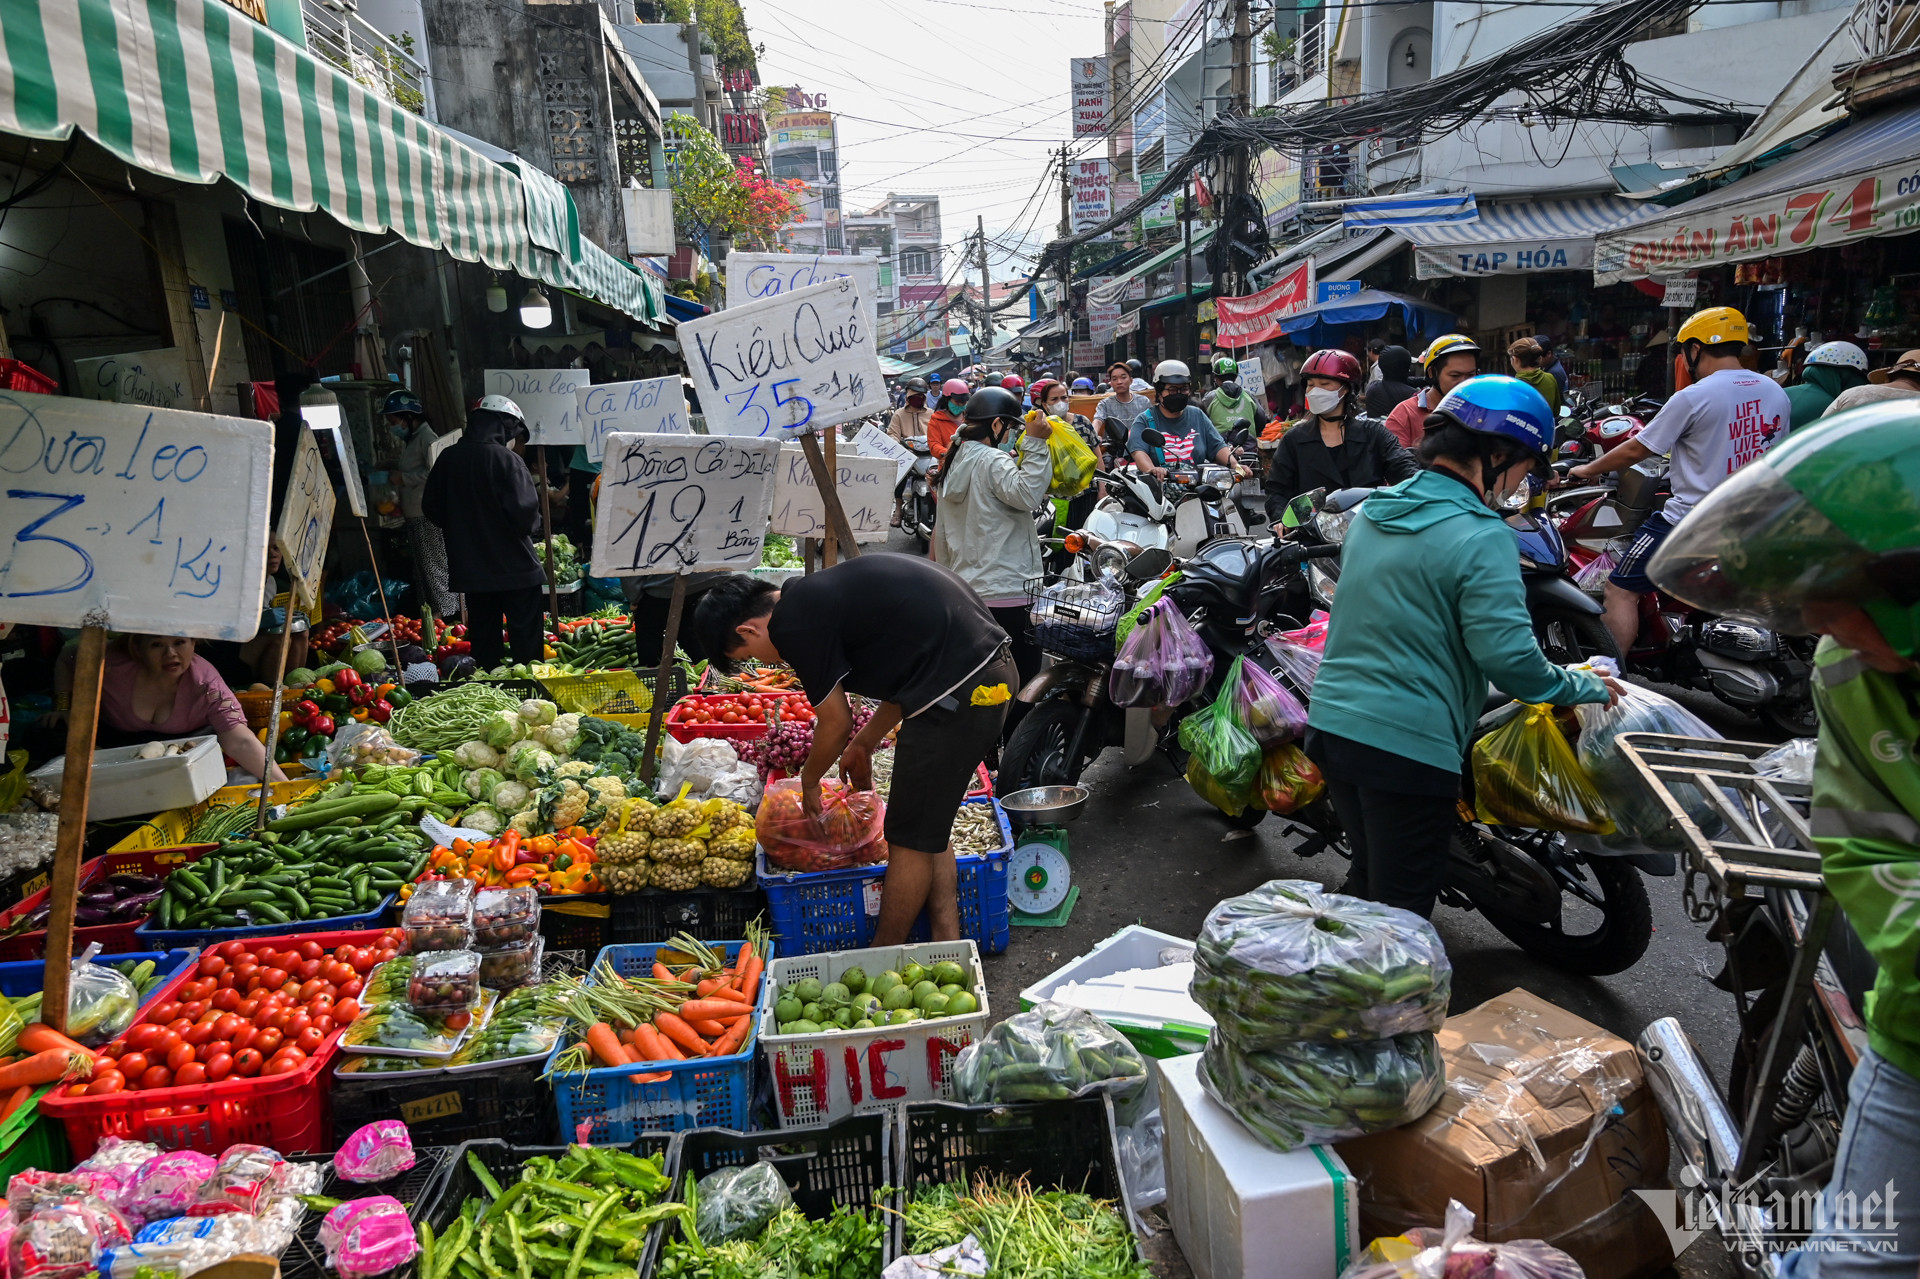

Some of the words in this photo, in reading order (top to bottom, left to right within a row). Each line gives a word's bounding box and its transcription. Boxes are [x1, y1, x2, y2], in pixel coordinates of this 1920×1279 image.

[1628, 226, 1717, 273] QUÁN
[1724, 213, 1780, 257] ĂN
[1784, 176, 1886, 246] 74
[1458, 251, 1508, 275] TẠP
[1516, 244, 1568, 269] HÓA
[724, 378, 816, 437] 35
[1736, 399, 1761, 419] LIFT
[1728, 414, 1766, 440] WELL
[1734, 433, 1761, 454] LIVE
[612, 484, 706, 571] 12
[728, 496, 745, 523] 1
[1057, 608, 1076, 617] HONDA
